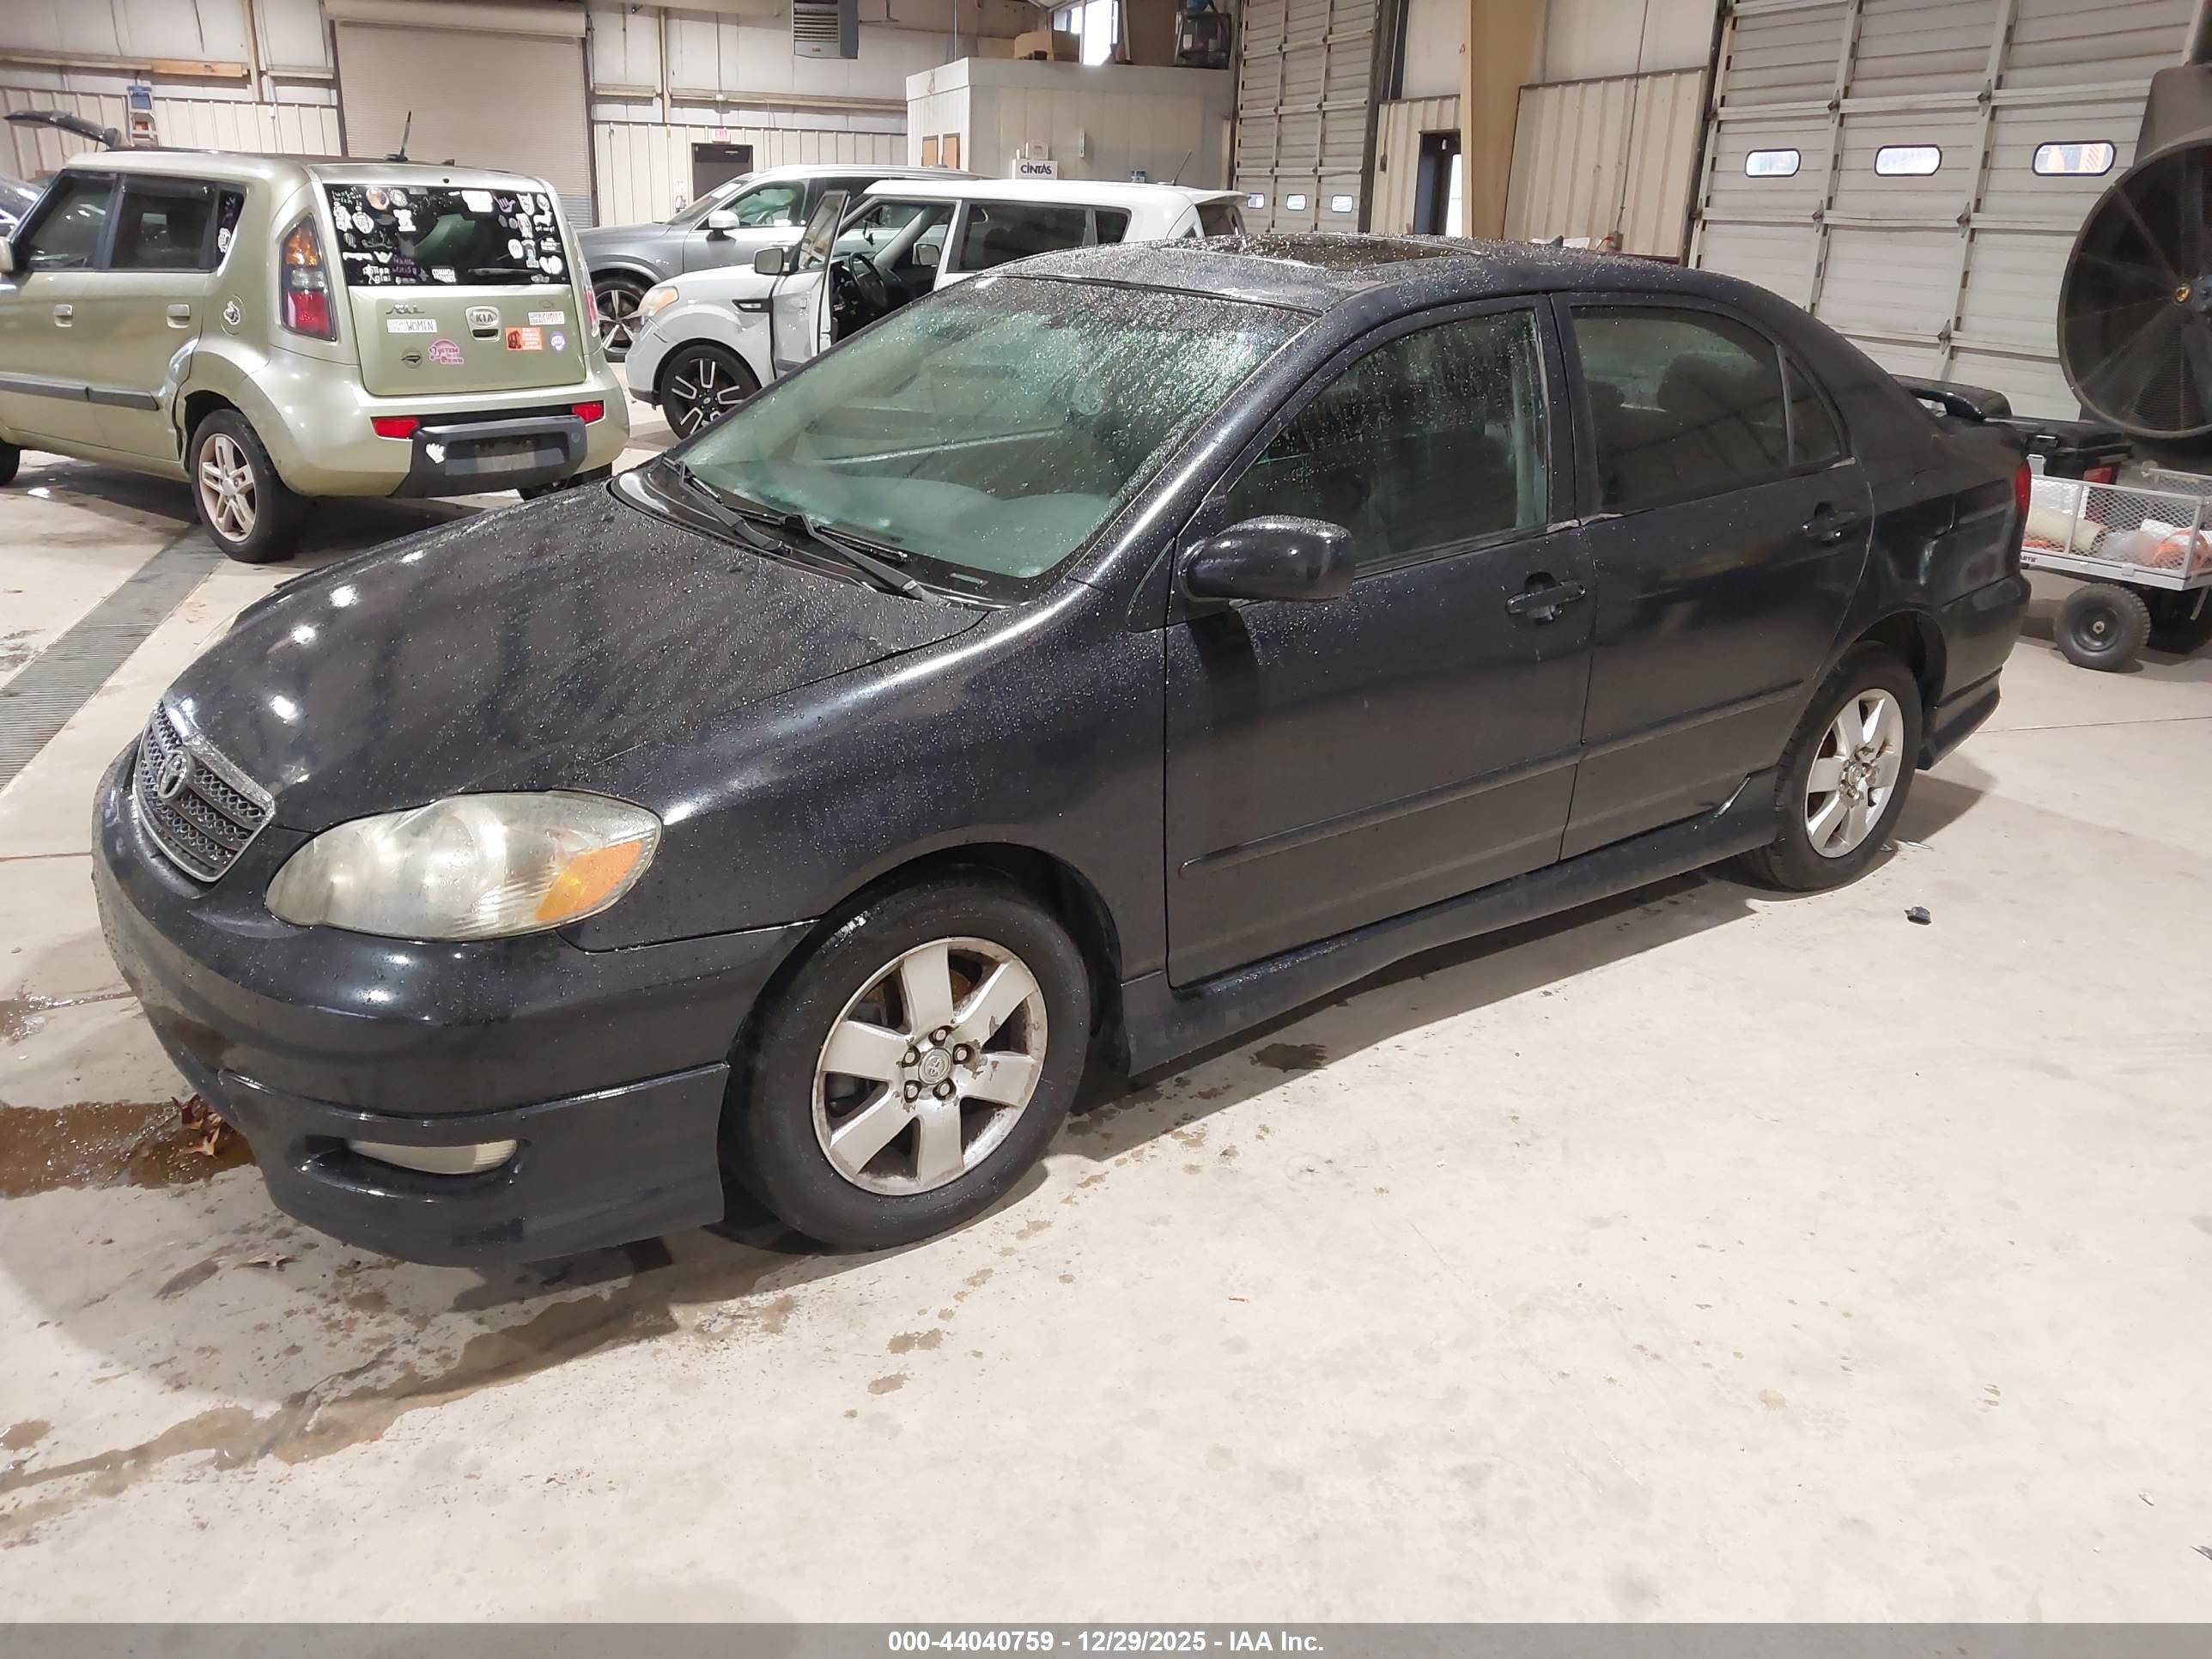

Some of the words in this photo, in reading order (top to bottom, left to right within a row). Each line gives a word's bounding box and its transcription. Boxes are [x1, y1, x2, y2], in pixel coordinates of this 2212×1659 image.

[1020, 161, 1052, 174] CINTAS
[474, 313, 494, 323] KIA
[405, 320, 434, 332] WOMEN
